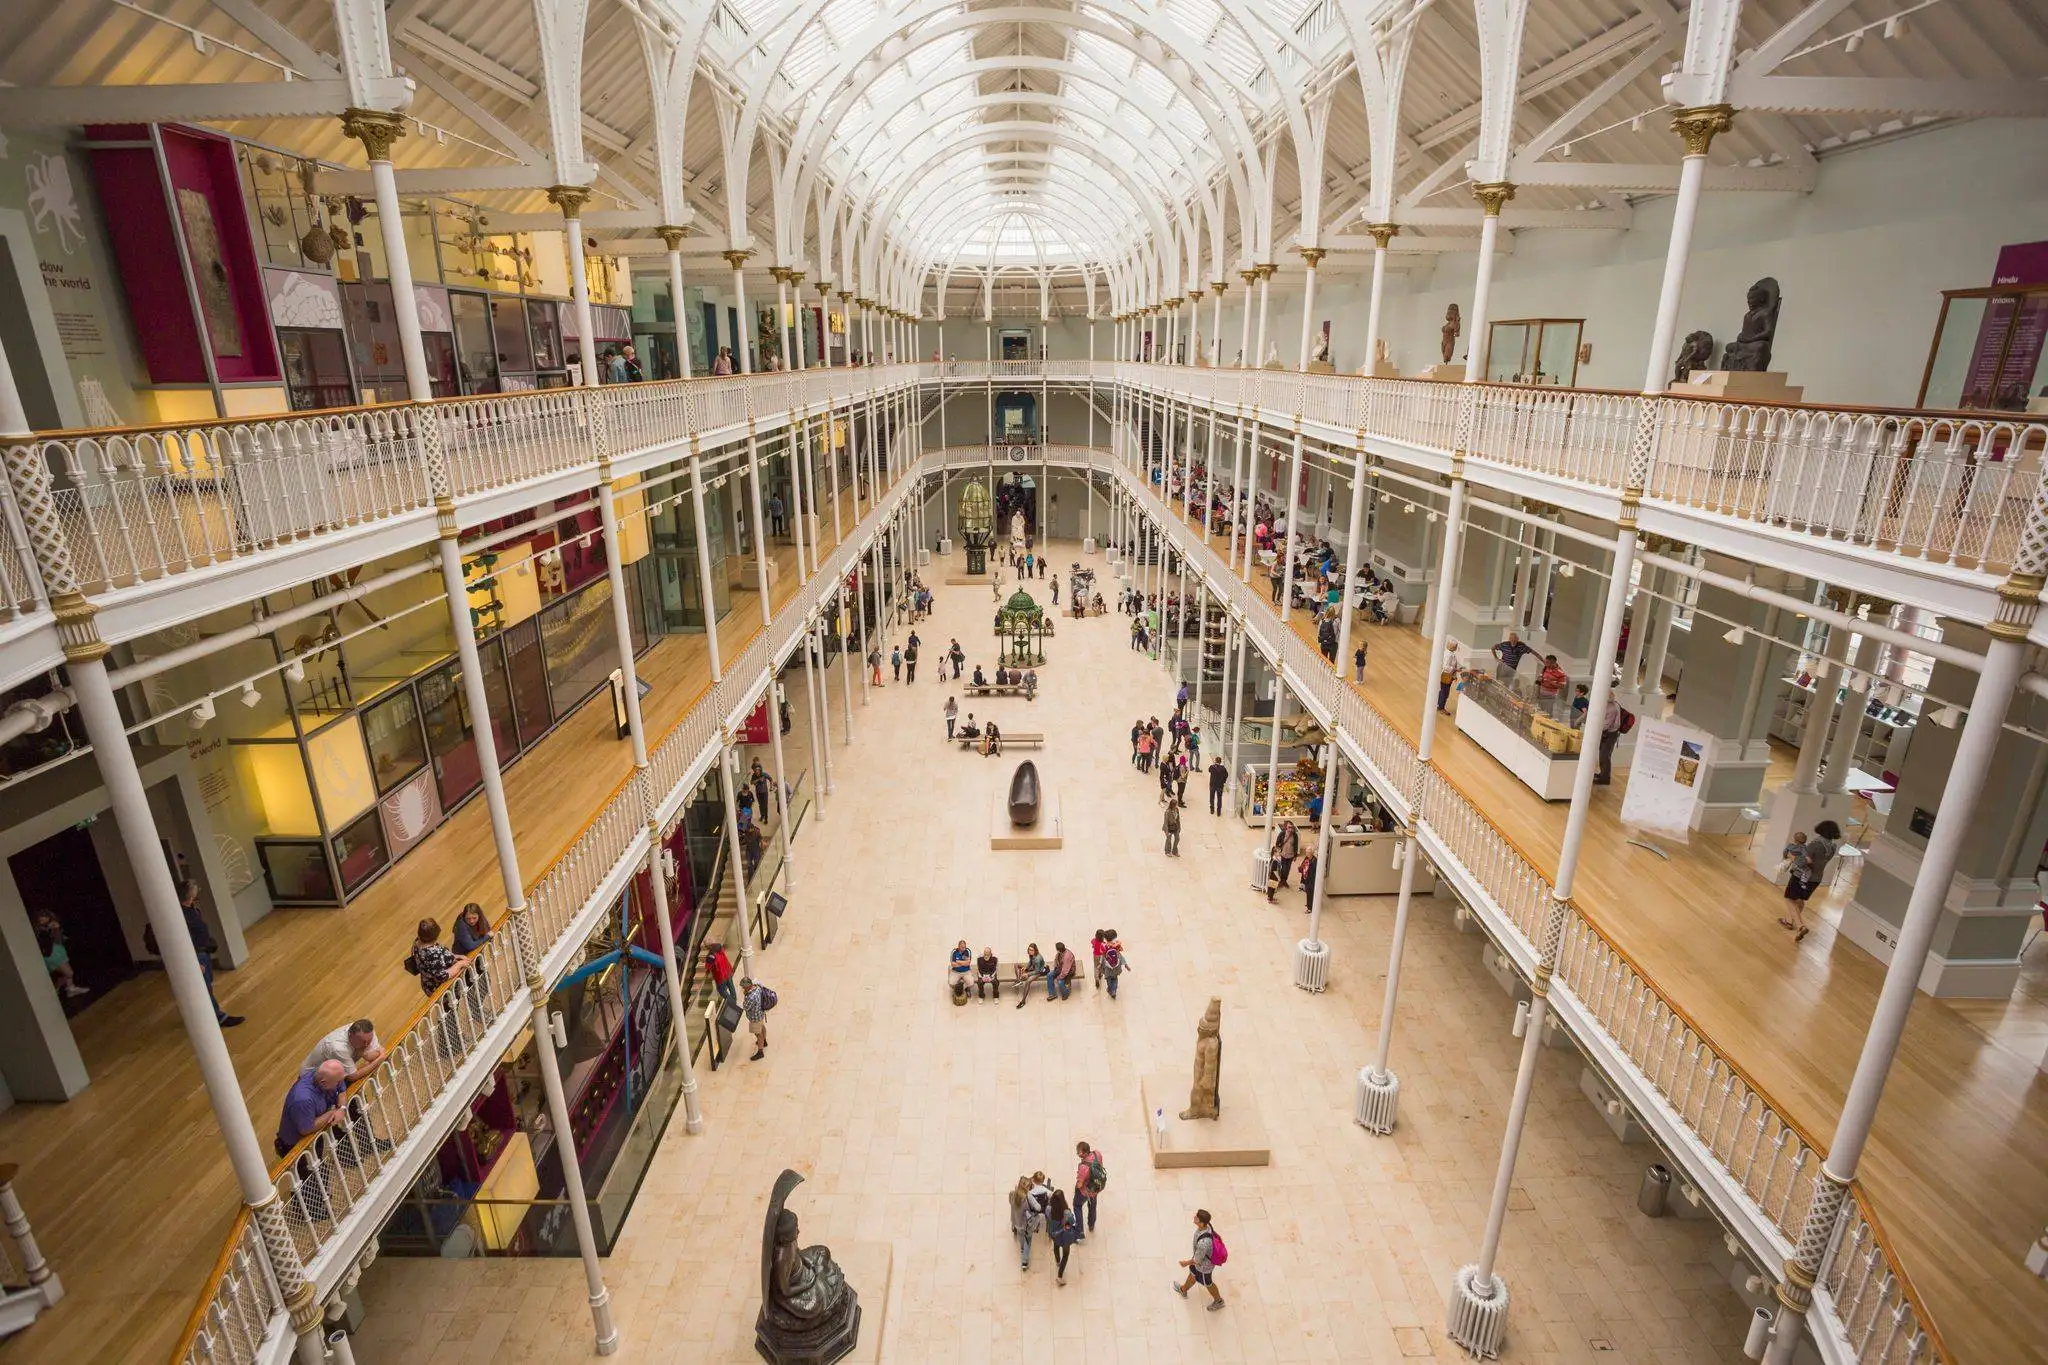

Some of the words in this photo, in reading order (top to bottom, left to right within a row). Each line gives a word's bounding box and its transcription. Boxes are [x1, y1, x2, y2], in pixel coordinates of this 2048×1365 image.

[40, 260, 63, 272] dow
[60, 277, 91, 290] world
[1997, 275, 2019, 284] Hindu
[199, 738, 221, 755] world
